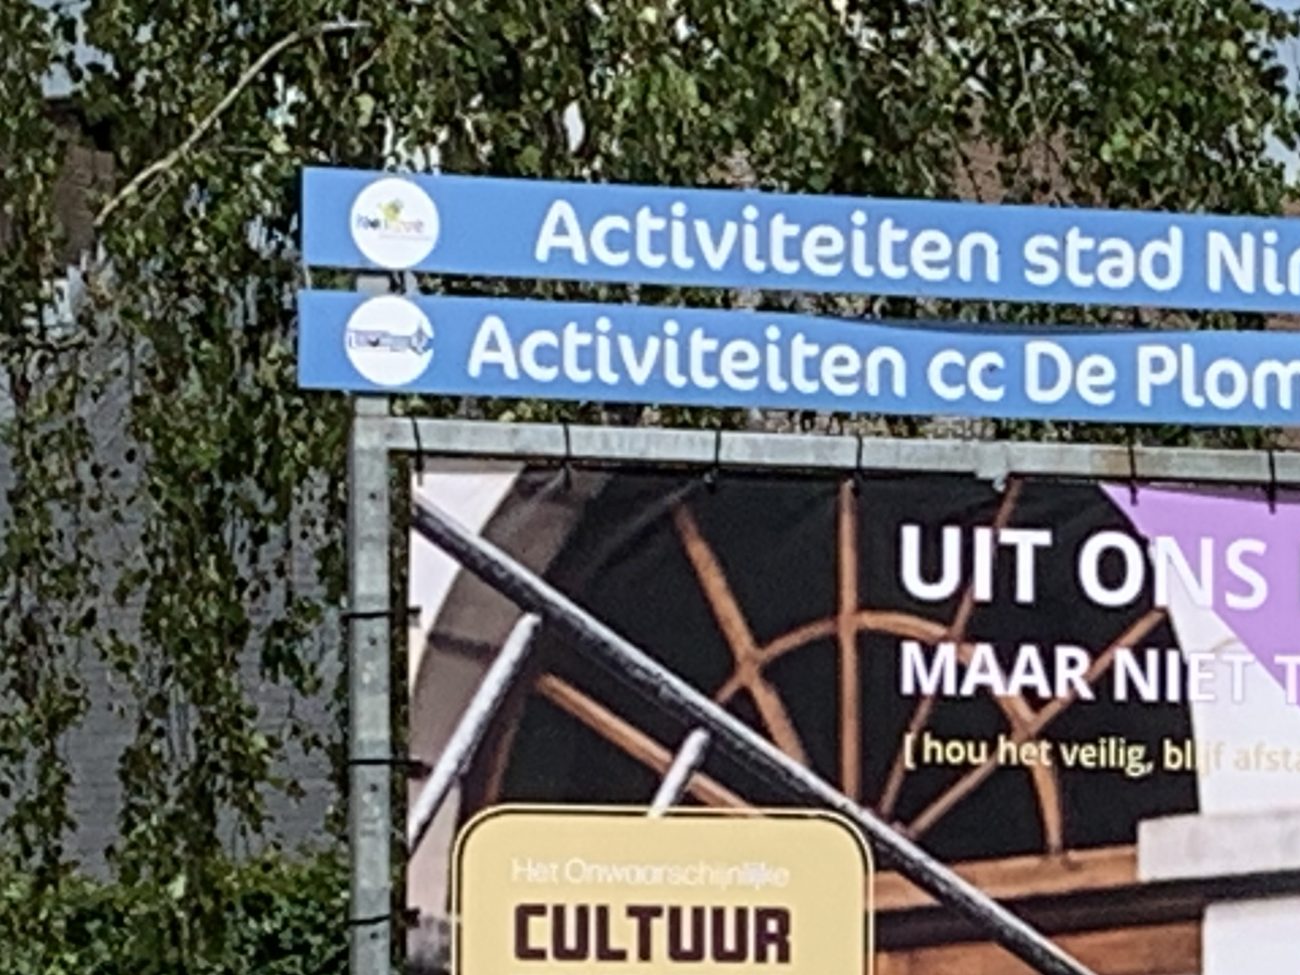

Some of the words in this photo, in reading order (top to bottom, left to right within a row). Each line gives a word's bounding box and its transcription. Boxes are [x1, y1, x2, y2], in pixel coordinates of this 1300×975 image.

[535, 199, 1000, 283] Activiteiten
[1023, 225, 1184, 291] stad
[467, 314, 907, 398] Activiteiten
[927, 348, 1005, 402] cc
[1025, 341, 1116, 404] De
[900, 525, 1051, 603] UIT
[1078, 529, 1268, 612] ONS
[901, 643, 1092, 700] MAAR
[1114, 646, 1256, 704] NIET
[923, 734, 987, 766] hou
[998, 734, 1052, 767] het
[1059, 736, 1155, 778] veilig,
[1163, 738, 1222, 780] blijf
[511, 857, 559, 885] Het
[514, 903, 791, 963] CULTUUR
